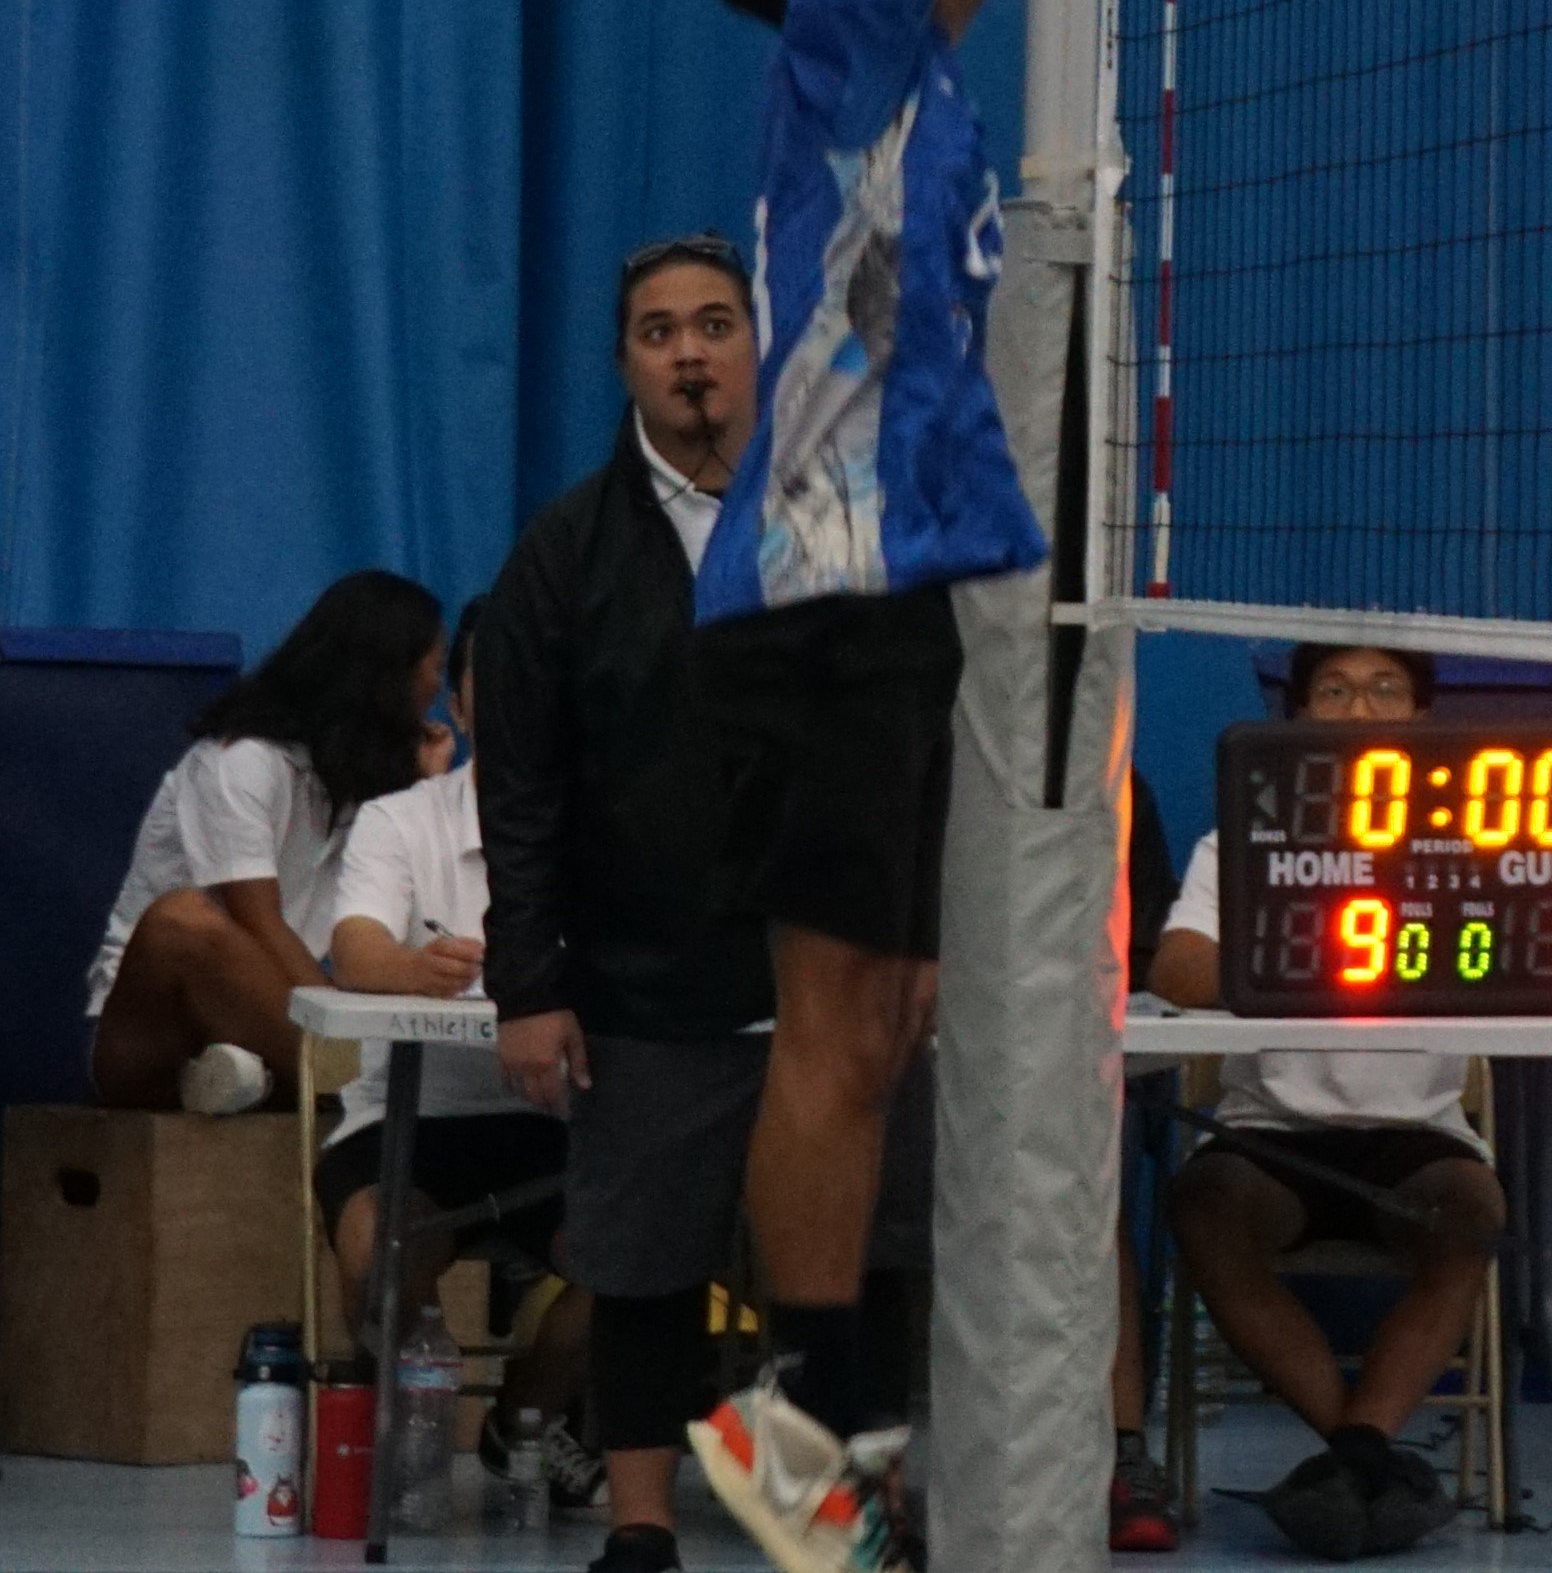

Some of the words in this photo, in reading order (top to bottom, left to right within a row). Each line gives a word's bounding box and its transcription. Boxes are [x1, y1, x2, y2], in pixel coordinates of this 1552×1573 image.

[1411, 838, 1474, 854] PERIOD
[1268, 851, 1375, 887] HOME
[1428, 875, 1439, 889] 2
[1449, 875, 1460, 889] 3
[1470, 875, 1481, 889] 4
[1338, 897, 1390, 983] 9
[1396, 922, 1429, 979] 0
[1458, 922, 1492, 979] 0
[388, 1011, 494, 1041] Athletic
